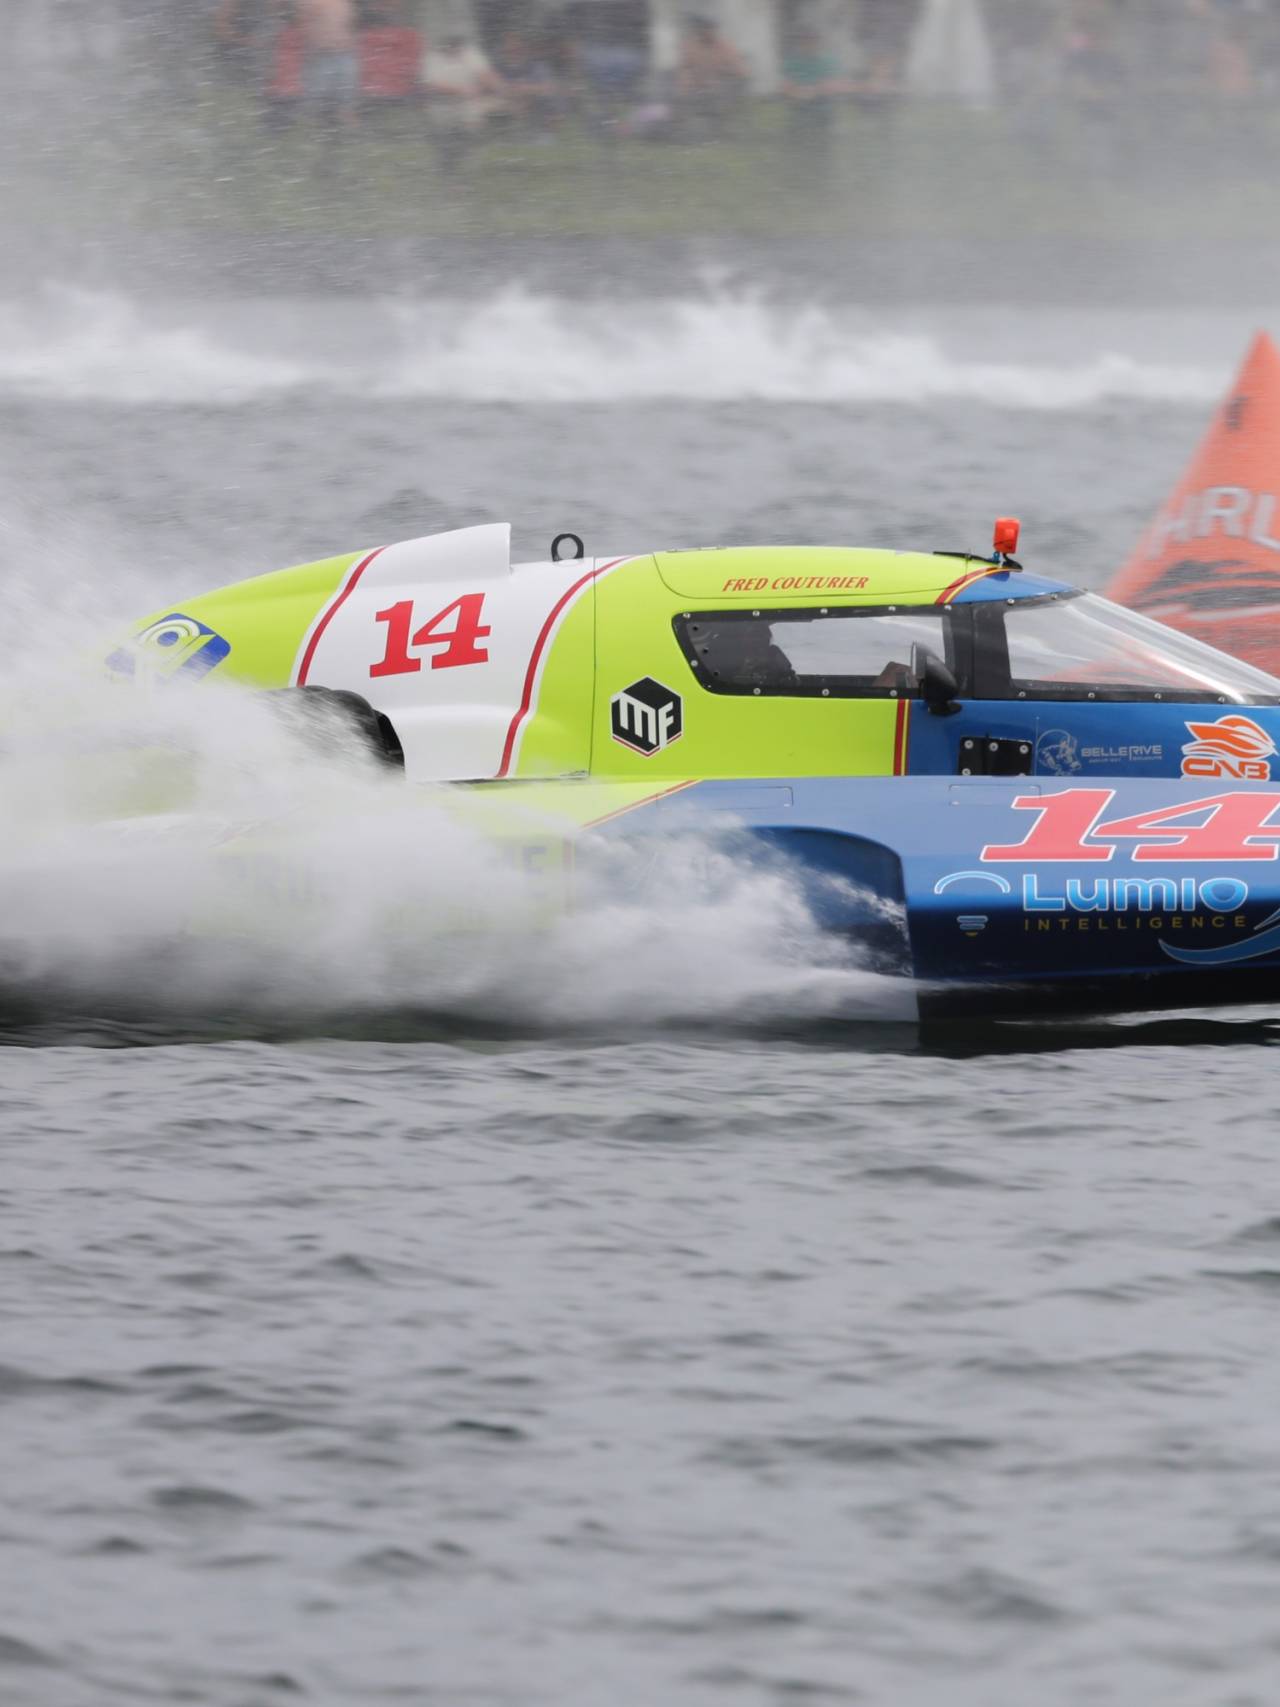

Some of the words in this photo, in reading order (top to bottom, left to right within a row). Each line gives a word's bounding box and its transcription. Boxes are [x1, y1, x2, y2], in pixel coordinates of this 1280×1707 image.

[722, 577, 769, 592] FRED
[771, 576, 870, 590] COUTURIER
[369, 592, 492, 678] 14
[1081, 745, 1163, 760] BELLERIVE
[1024, 915, 1247, 930] INTELLIGENCE
